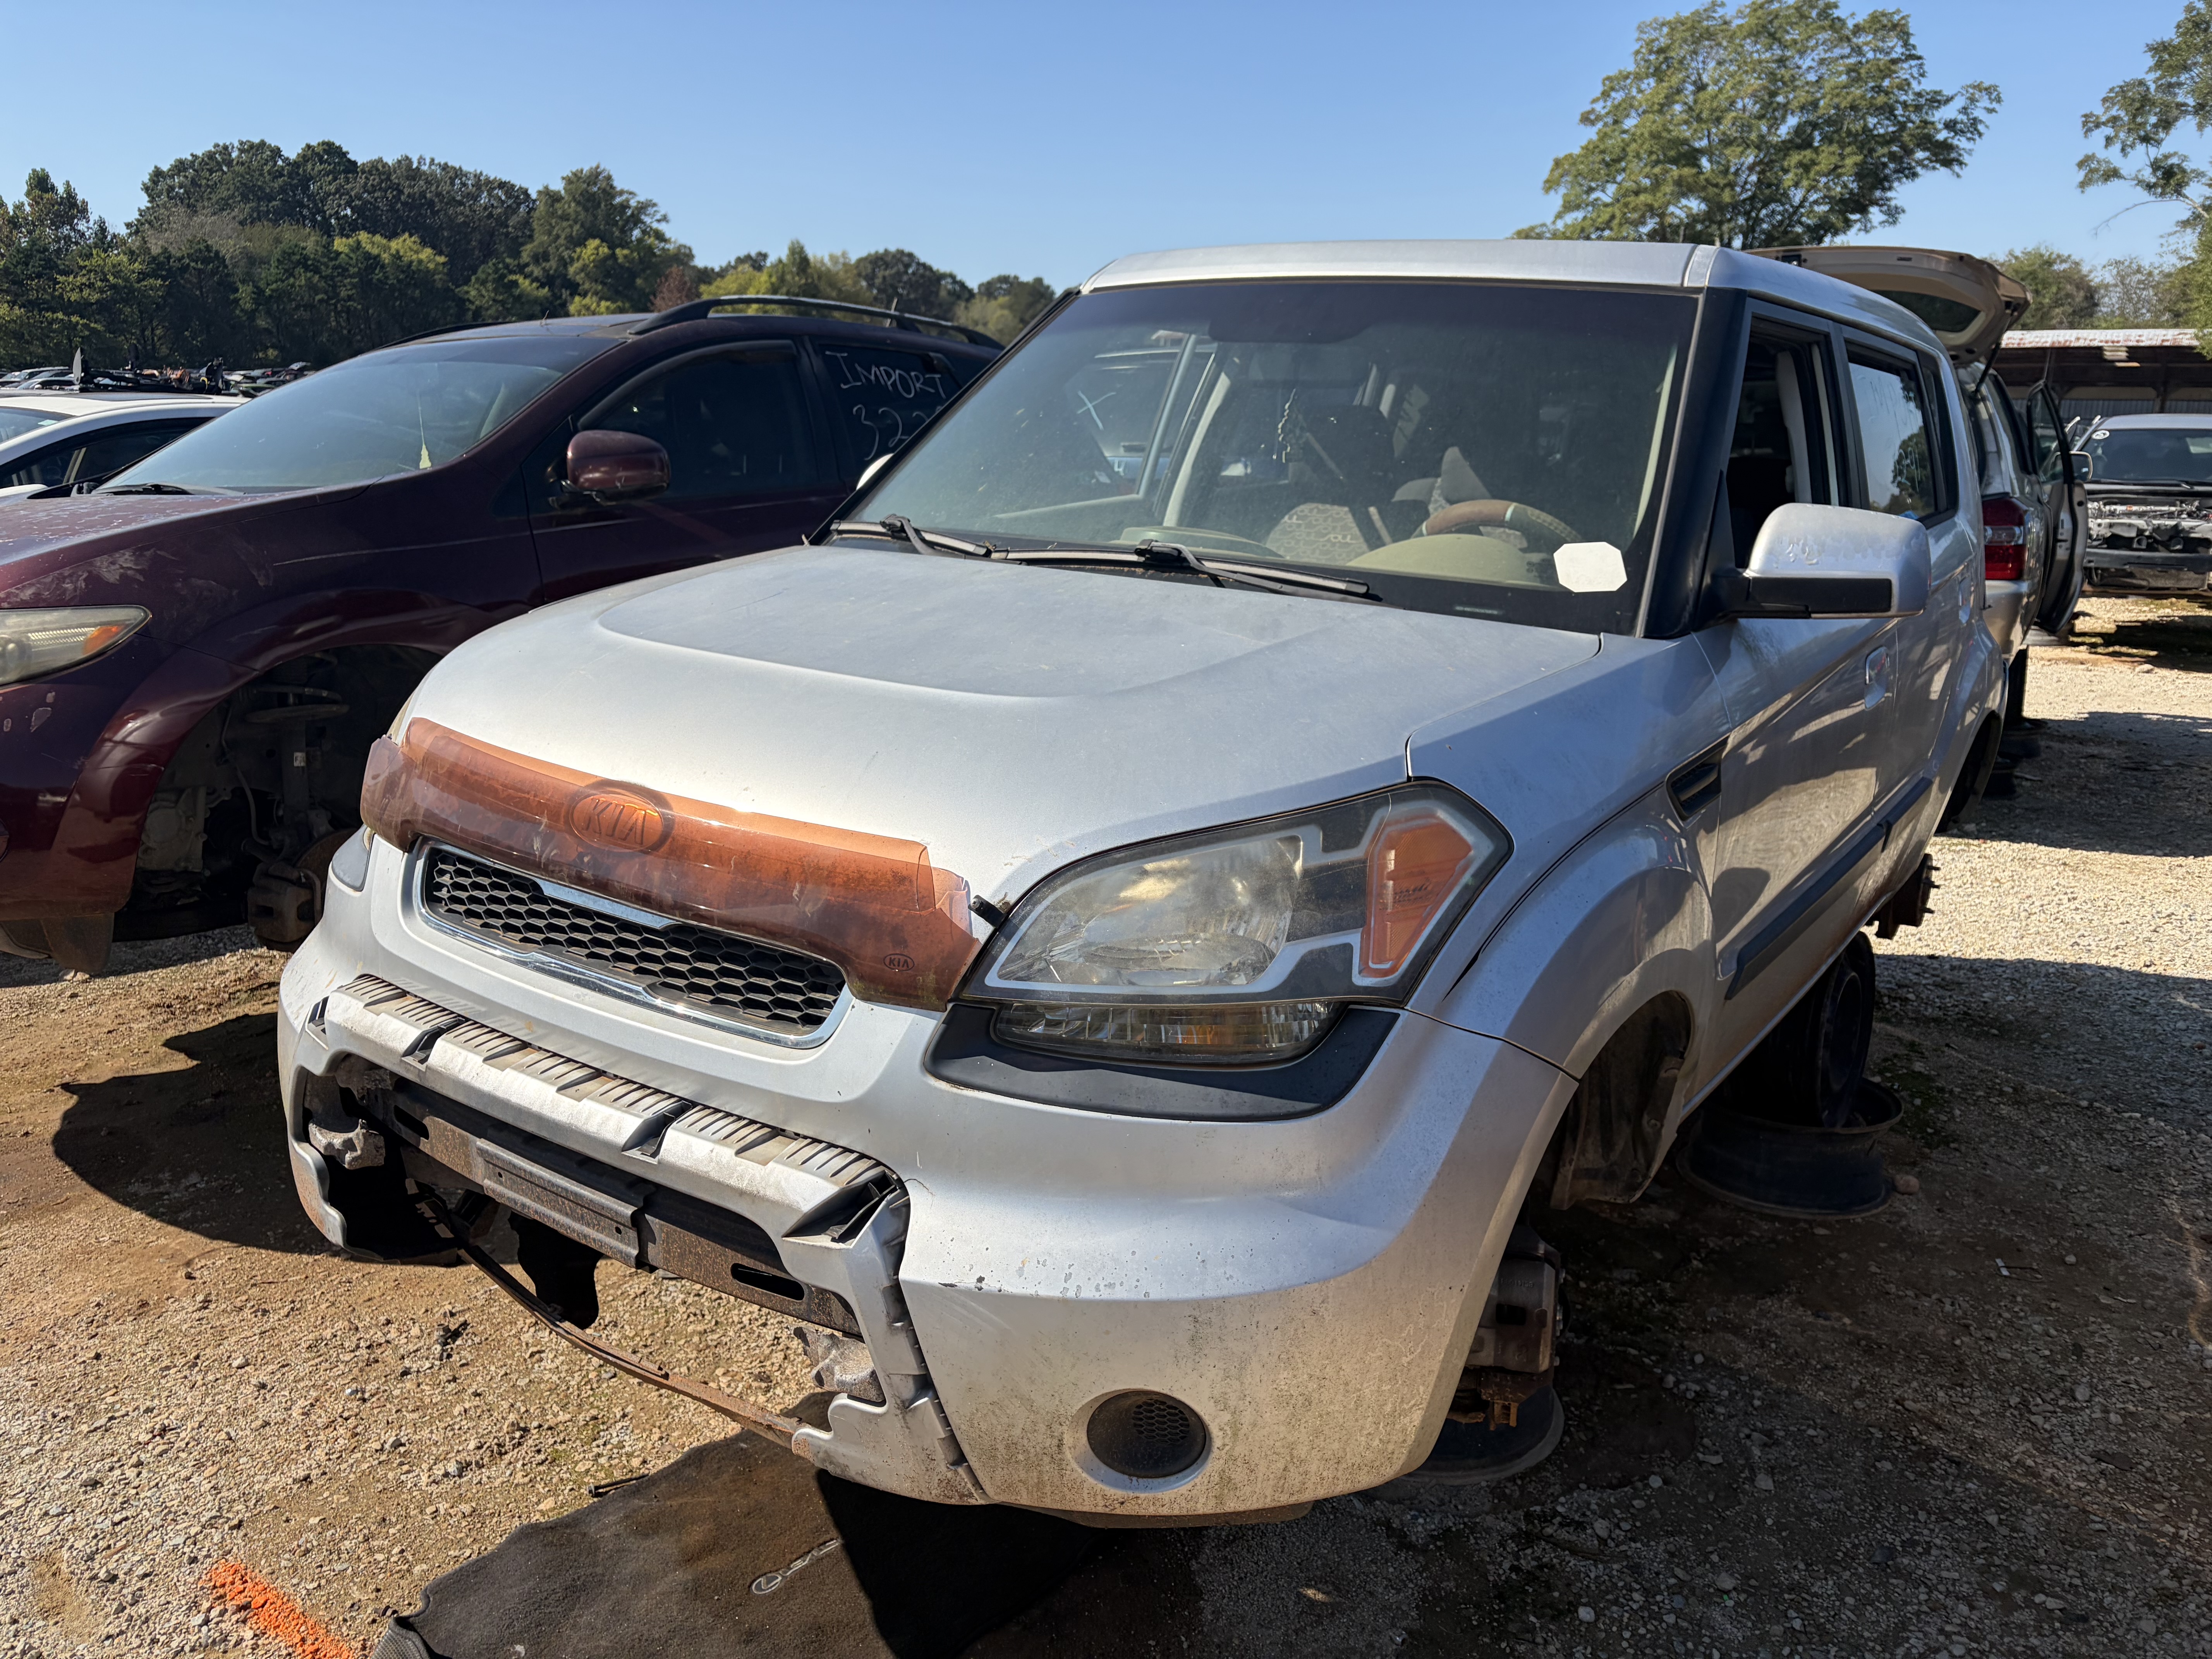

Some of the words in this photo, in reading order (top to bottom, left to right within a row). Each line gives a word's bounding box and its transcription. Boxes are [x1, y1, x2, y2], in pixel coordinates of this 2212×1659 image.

[825, 350, 946, 399] IMPORT
[582, 797, 647, 845] KIA
[889, 957, 909, 968] KIA
